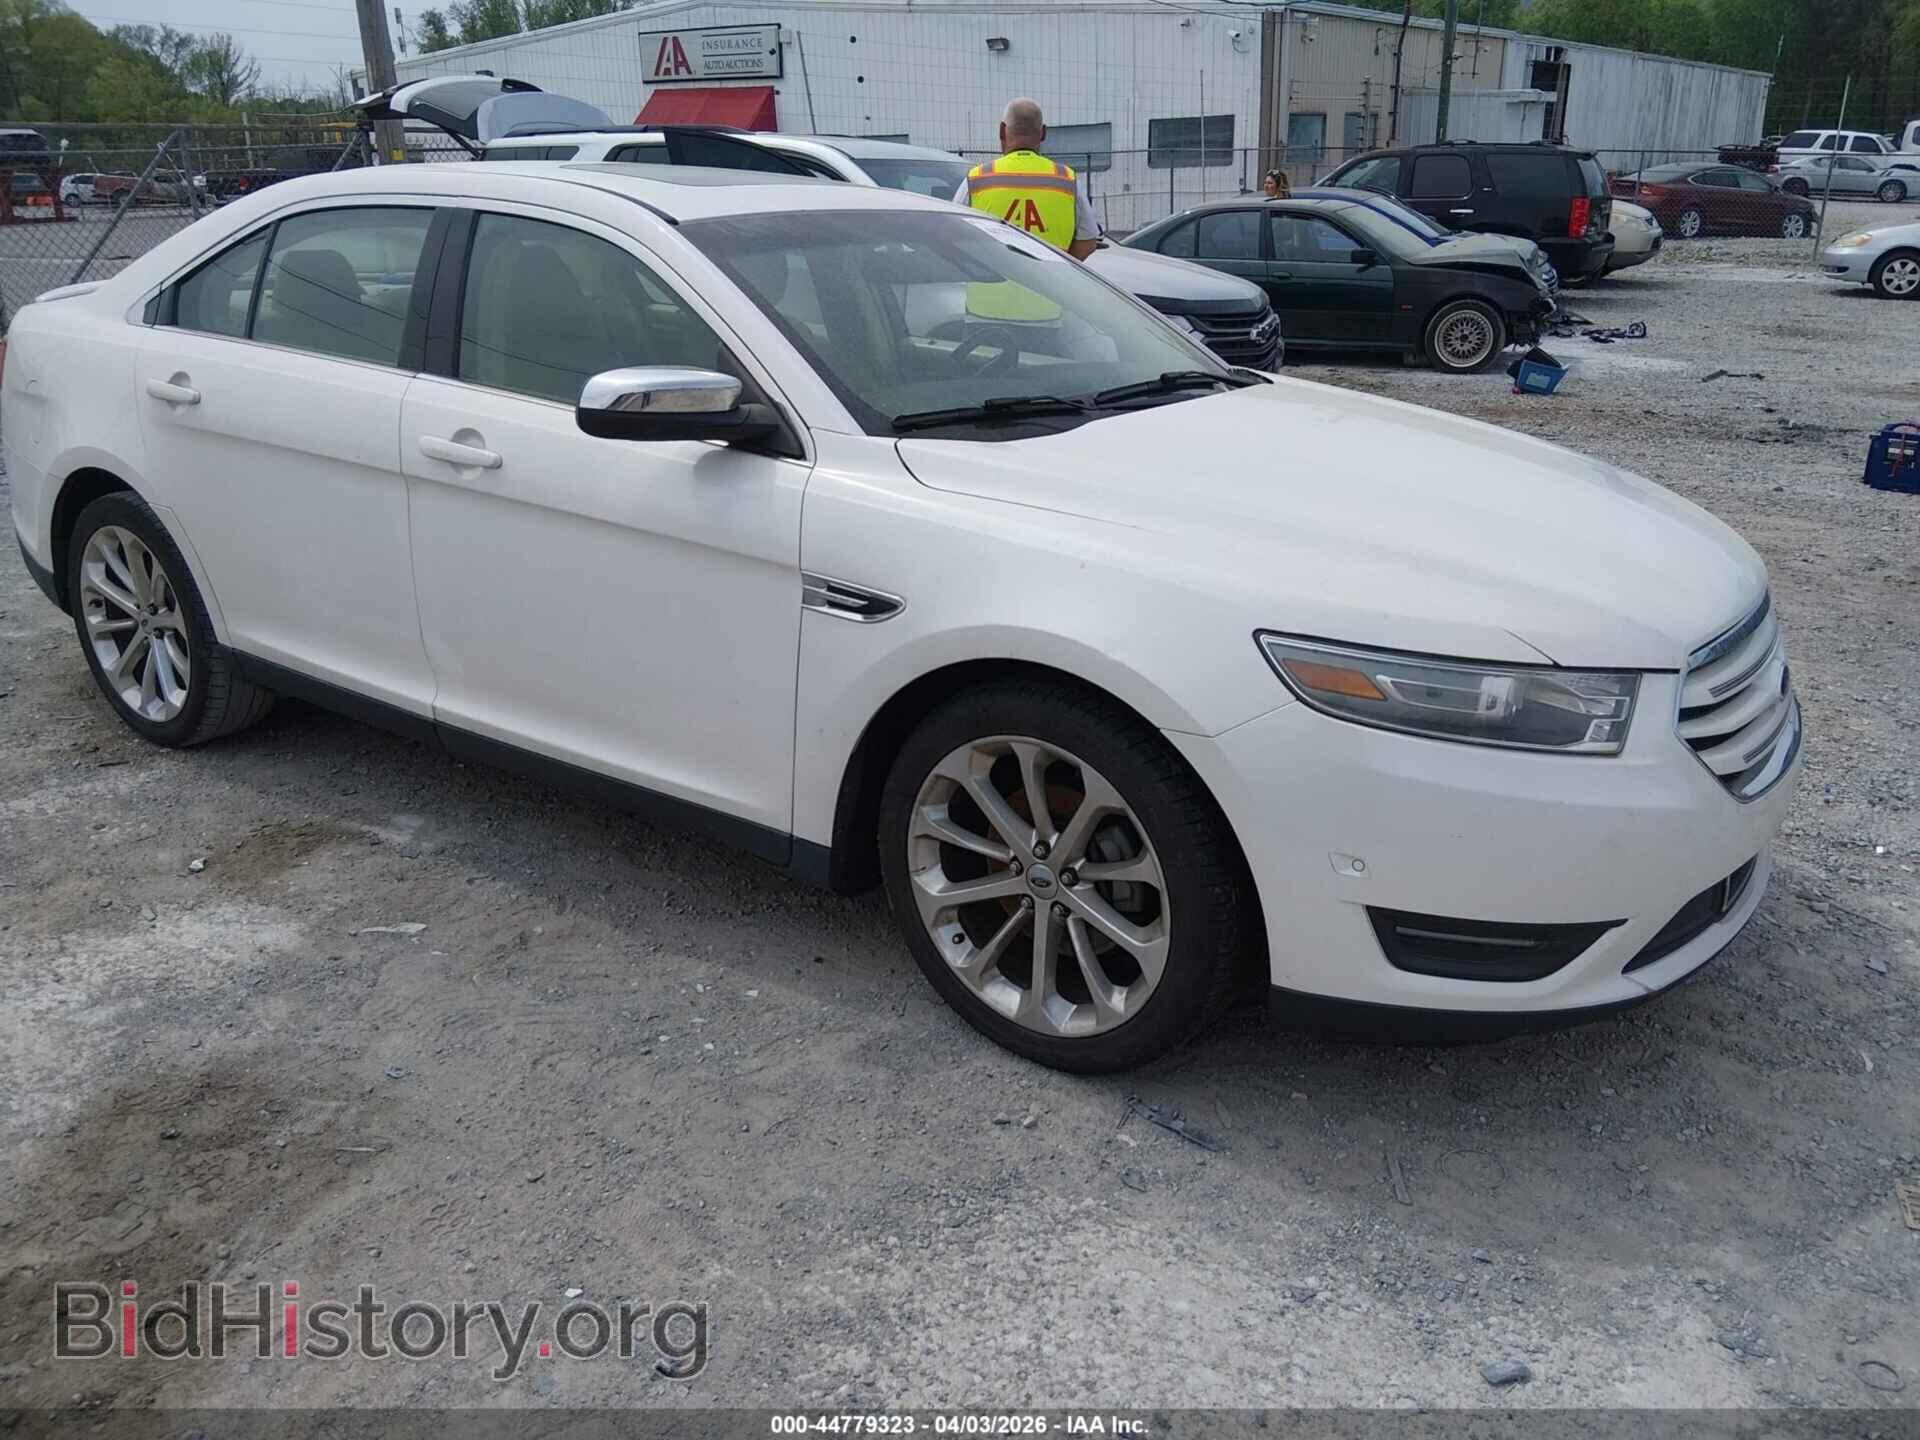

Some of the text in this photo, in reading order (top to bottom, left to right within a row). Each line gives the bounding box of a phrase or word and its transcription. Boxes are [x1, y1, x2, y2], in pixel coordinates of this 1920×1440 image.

[702, 38, 762, 50] INSURANCE
[703, 58, 764, 70] AUTO AUCTIONS
